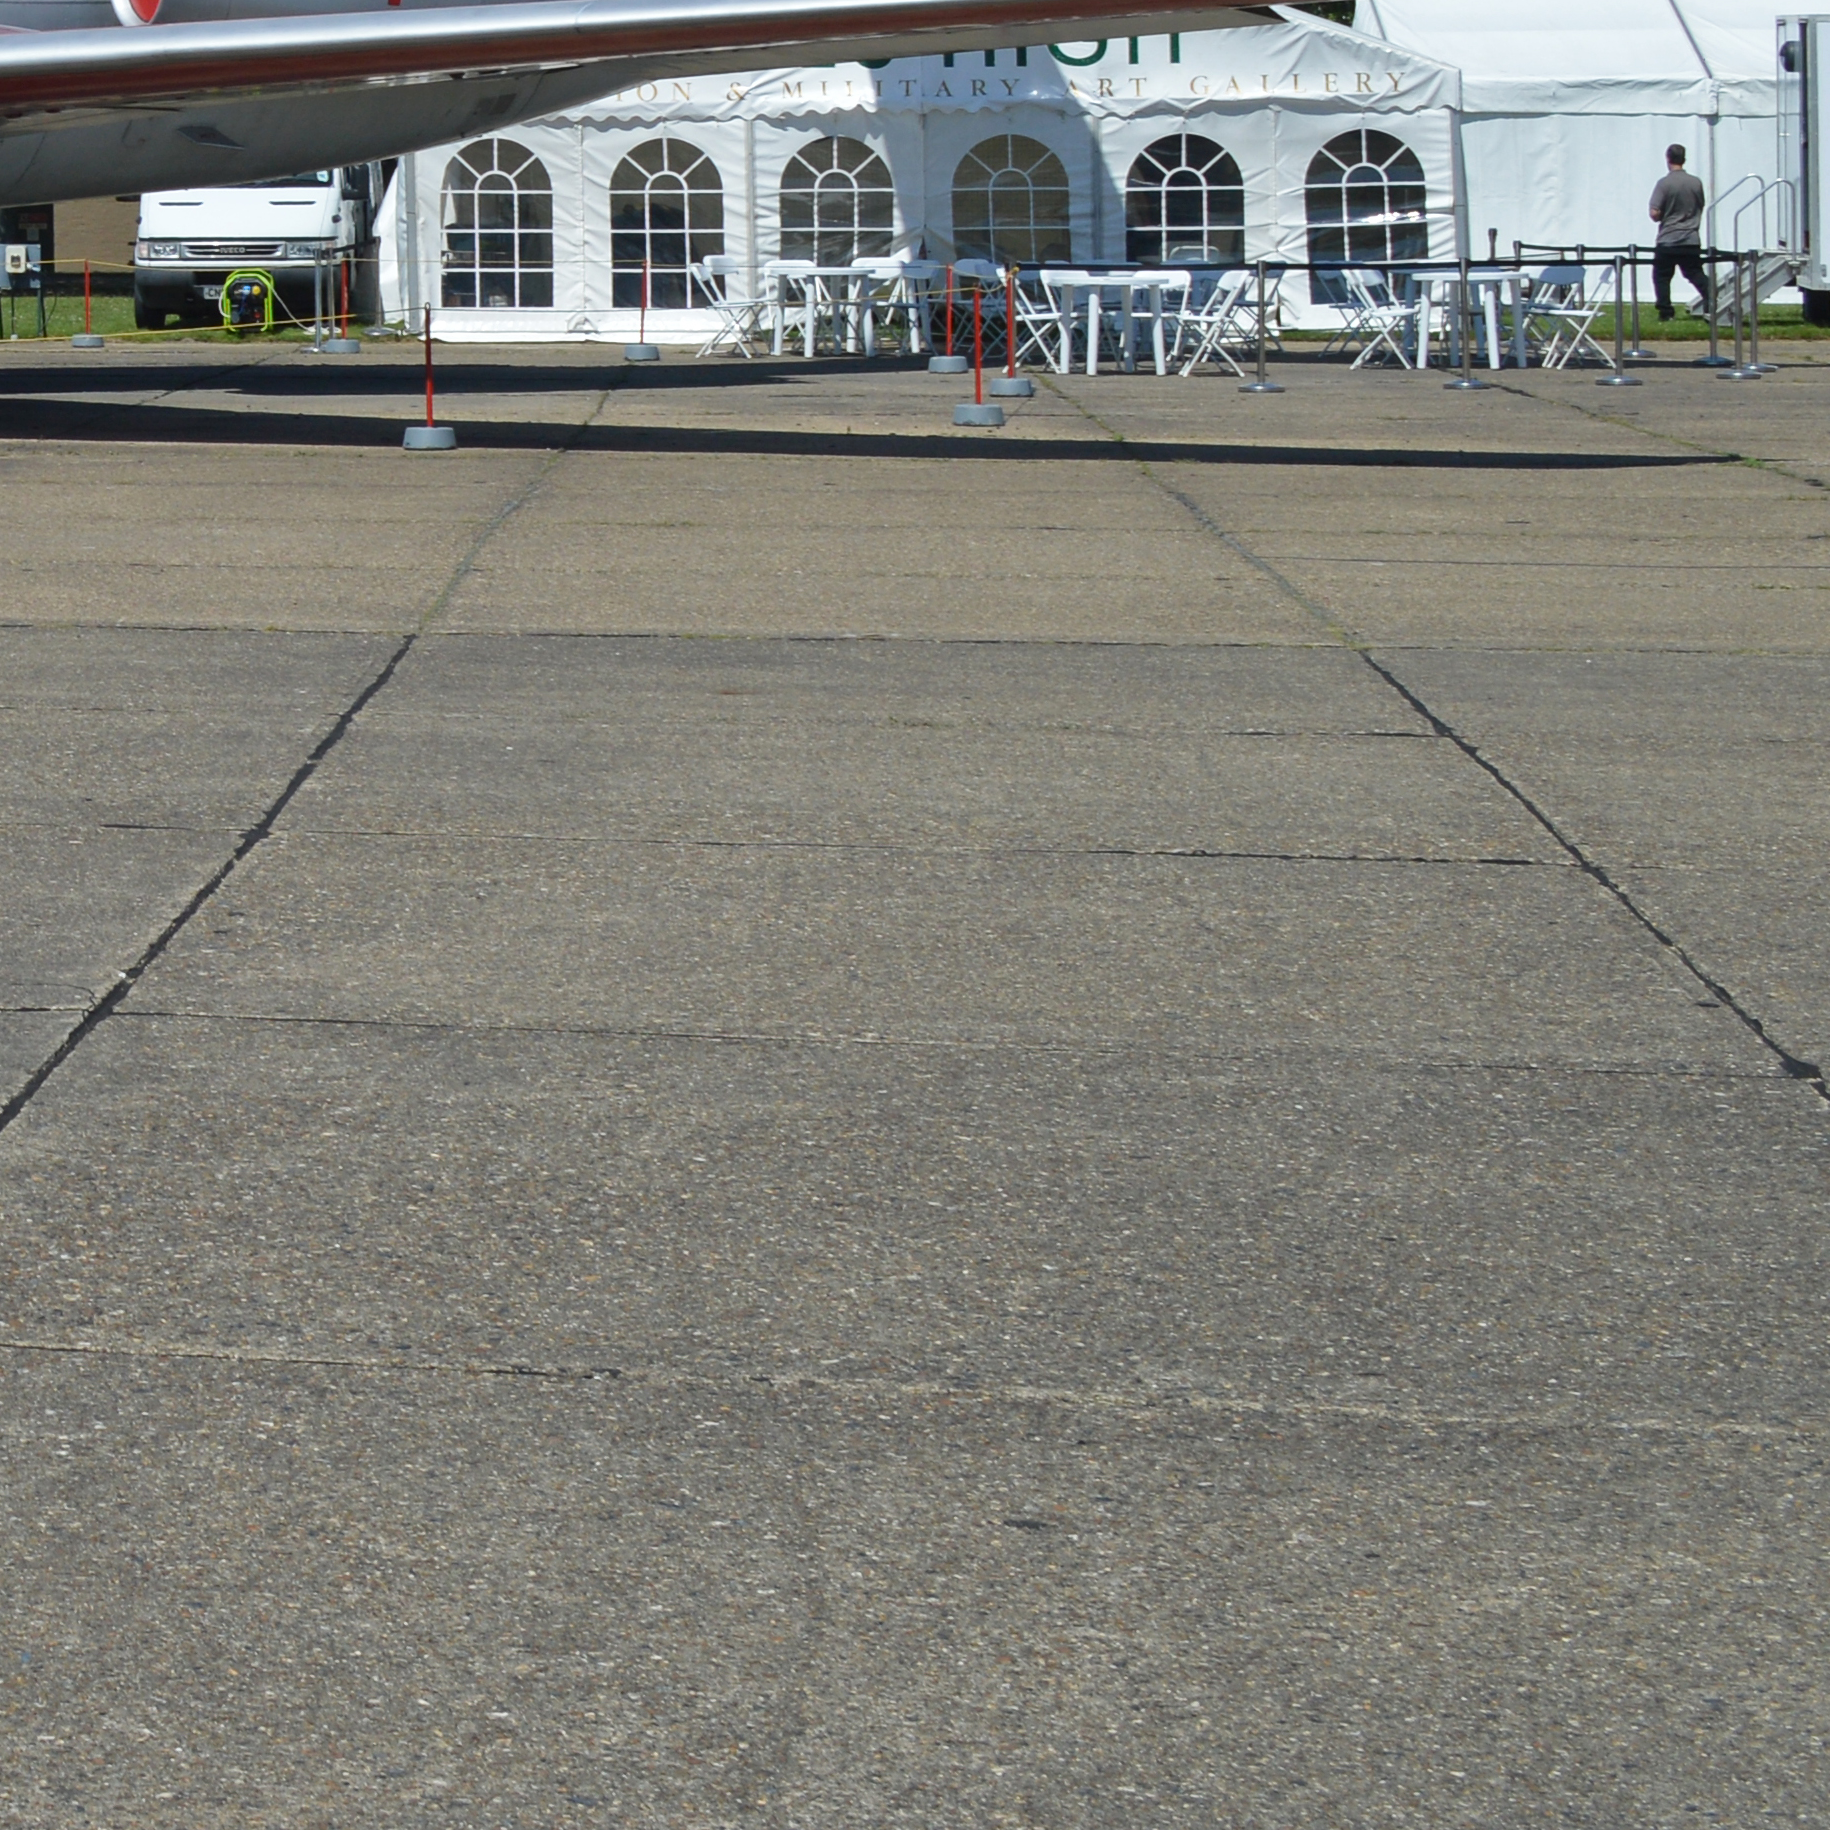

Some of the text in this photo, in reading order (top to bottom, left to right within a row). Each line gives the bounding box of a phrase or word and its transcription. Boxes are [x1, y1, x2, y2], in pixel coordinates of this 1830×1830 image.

[726, 82, 751, 102] &
[782, 78, 1021, 98] MILITARY
[1064, 76, 1148, 97] ART
[1191, 71, 1406, 95] GALLERY
